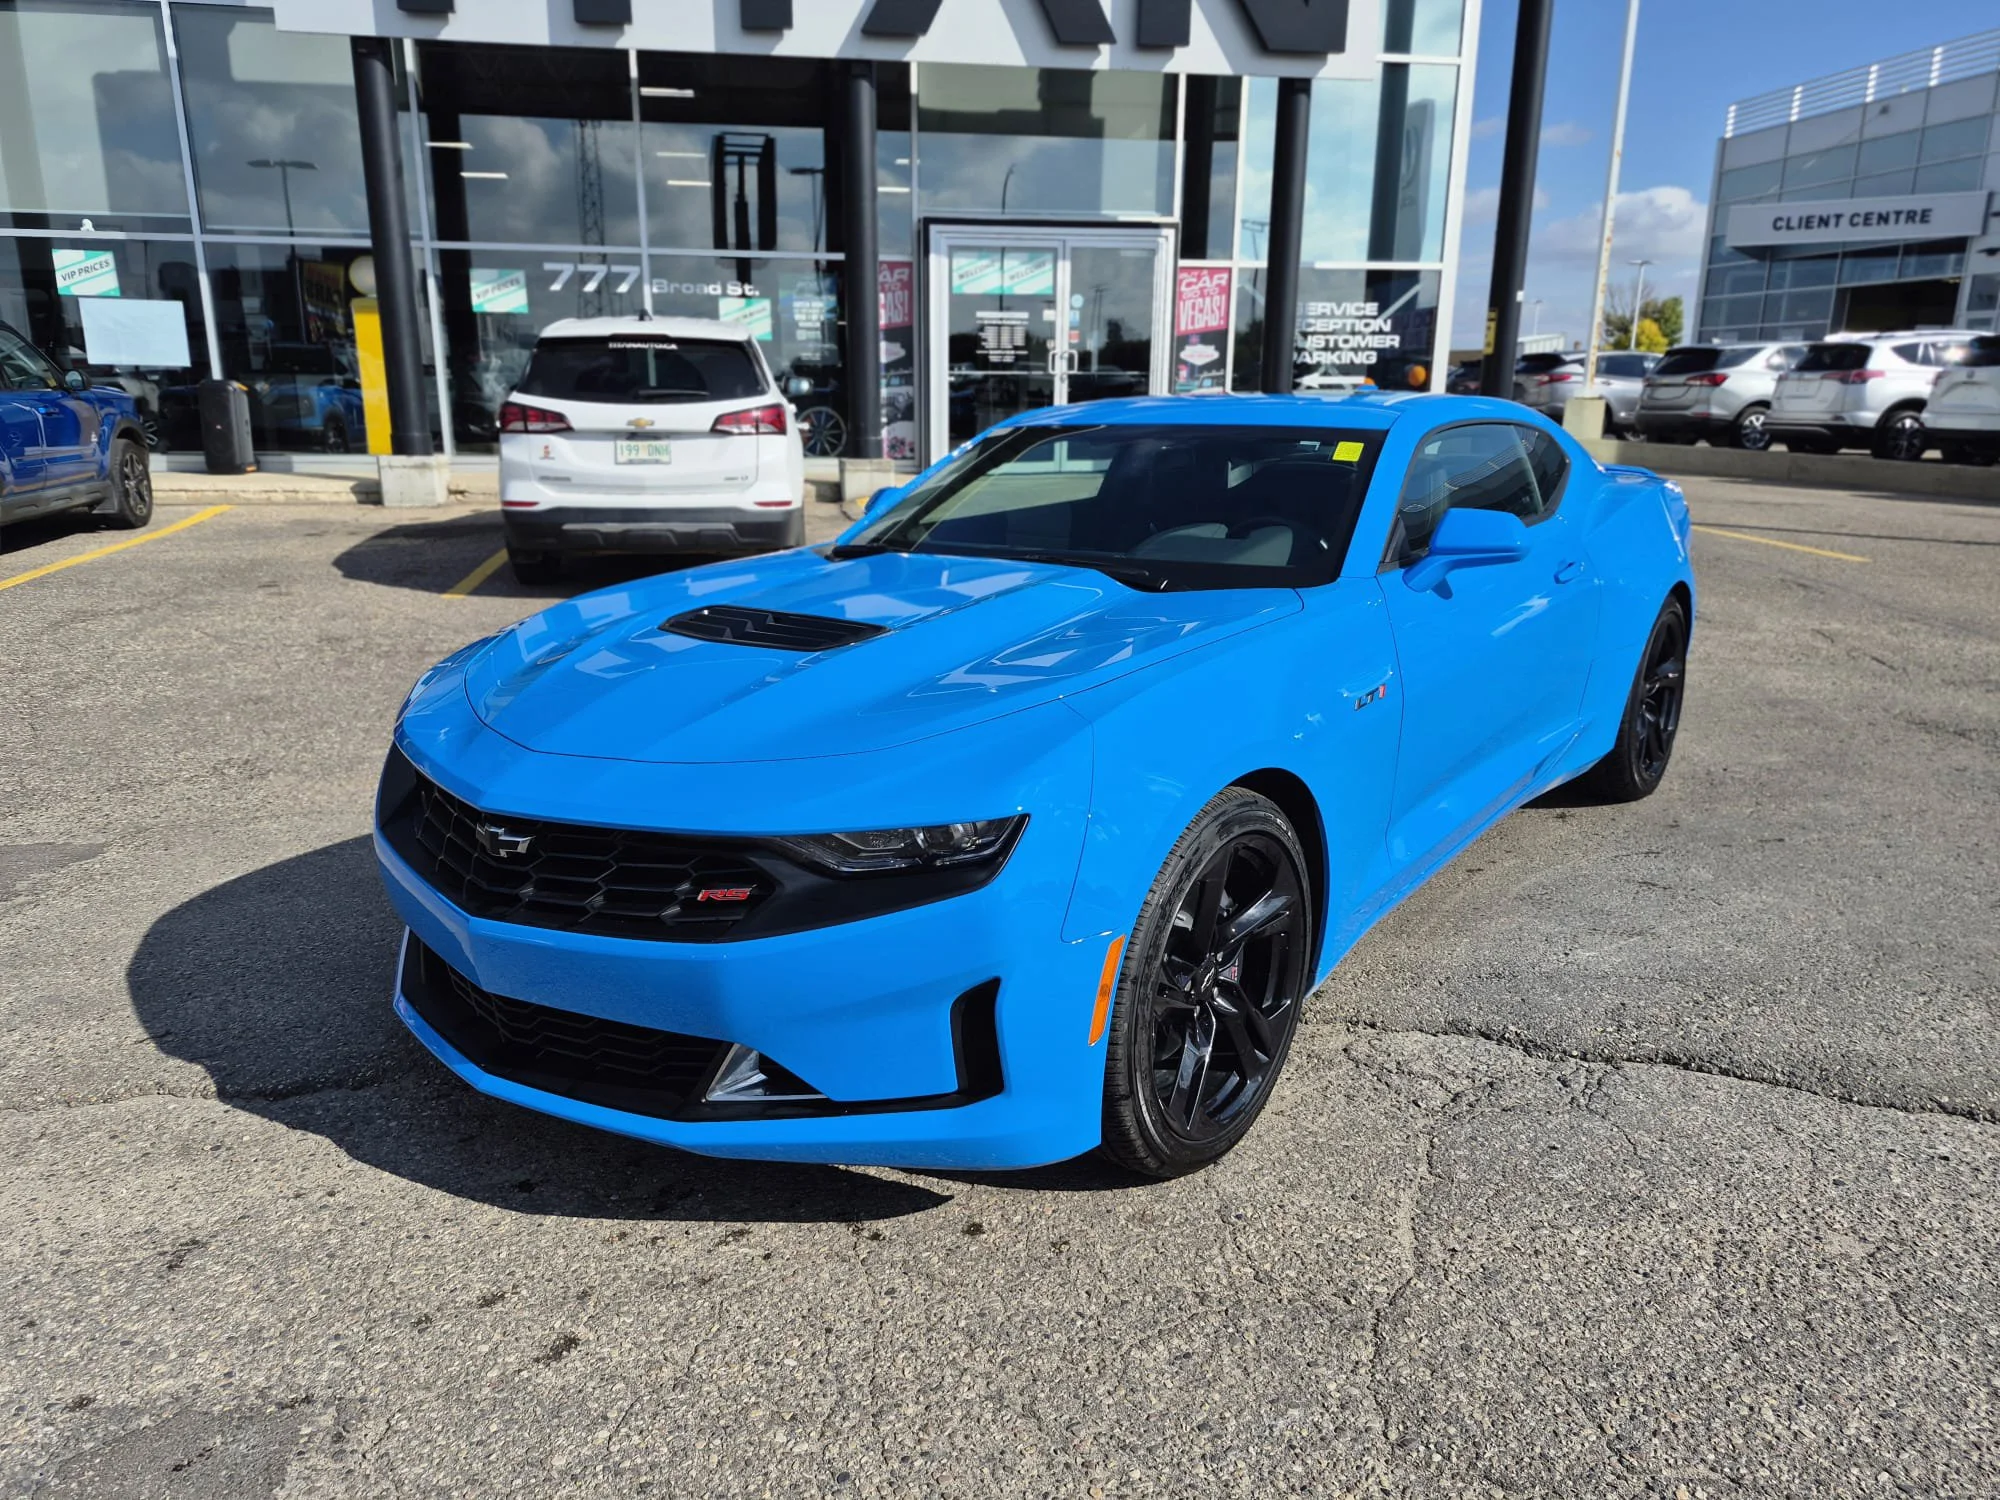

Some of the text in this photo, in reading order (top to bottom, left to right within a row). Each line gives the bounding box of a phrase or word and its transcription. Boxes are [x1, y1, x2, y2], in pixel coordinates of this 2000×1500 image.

[1772, 208, 1933, 231] CLIENT CENTRE
[61, 259, 110, 281] VIP PRICES
[543, 262, 760, 296] 777 Broad St.
[1180, 273, 1229, 292] CAR
[1180, 294, 1226, 332] VEGAS!
[1295, 334, 1400, 349] USTOMER
[1293, 351, 1377, 365] ARKING
[1354, 683, 1386, 711] LT1
[697, 887, 752, 901] RS
